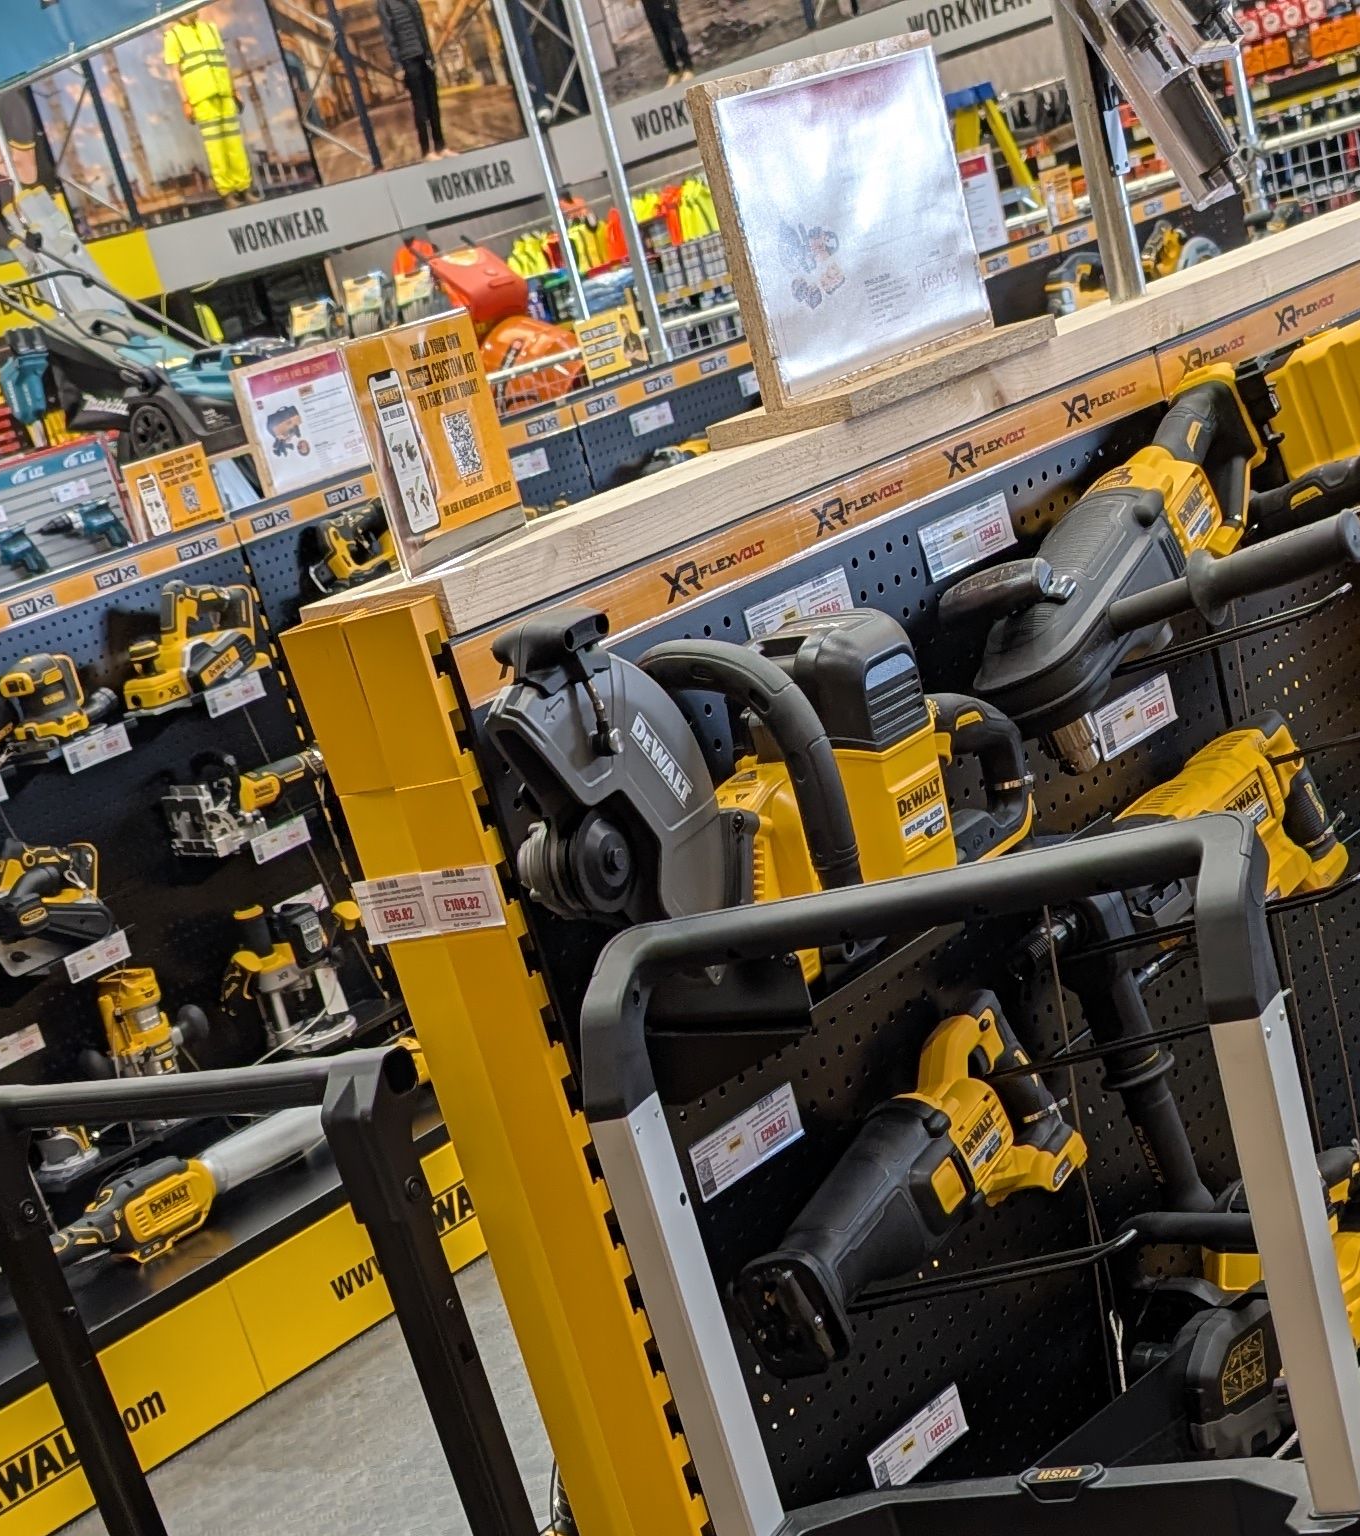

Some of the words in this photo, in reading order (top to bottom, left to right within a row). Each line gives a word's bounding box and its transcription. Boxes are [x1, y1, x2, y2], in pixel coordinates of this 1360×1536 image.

[632, 99, 689, 141] WORK
[426, 159, 514, 204] WORKWEAR
[227, 207, 329, 255] WORKWEAR
[1275, 306, 1300, 336] XR
[1296, 293, 1336, 318] FLEXVOLT
[432, 356, 465, 384] CUSTOM
[464, 351, 479, 374] KIT
[1177, 346, 1206, 375] XR
[1199, 335, 1246, 361] FLEXVOLT
[1060, 394, 1091, 428] XR
[1088, 381, 1138, 407] FLEXVOLT
[942, 443, 976, 478] XR
[973, 428, 1027, 455] FLEXVOLT
[325, 487, 346, 505] 18V
[810, 498, 848, 537] XR
[844, 477, 905, 512] FLEXVOLT
[251, 514, 272, 533] 18V
[270, 508, 291, 526] XR
[177, 542, 199, 560] 18V
[197, 536, 220, 555] XR
[96, 569, 118, 589] 18V
[117, 564, 139, 583] XR
[661, 560, 703, 603] XR
[699, 538, 766, 575] FLEXVOLT
[10, 597, 34, 619] 18V
[33, 592, 55, 611] XR
[629, 712, 694, 807] DEWALT
[897, 777, 942, 819] DEWALT
[383, 906, 416, 924] £95.82
[443, 895, 482, 912] £108.32
[148, 1183, 190, 1214] DEWALT
[1037, 1467, 1083, 1481] PUSH
